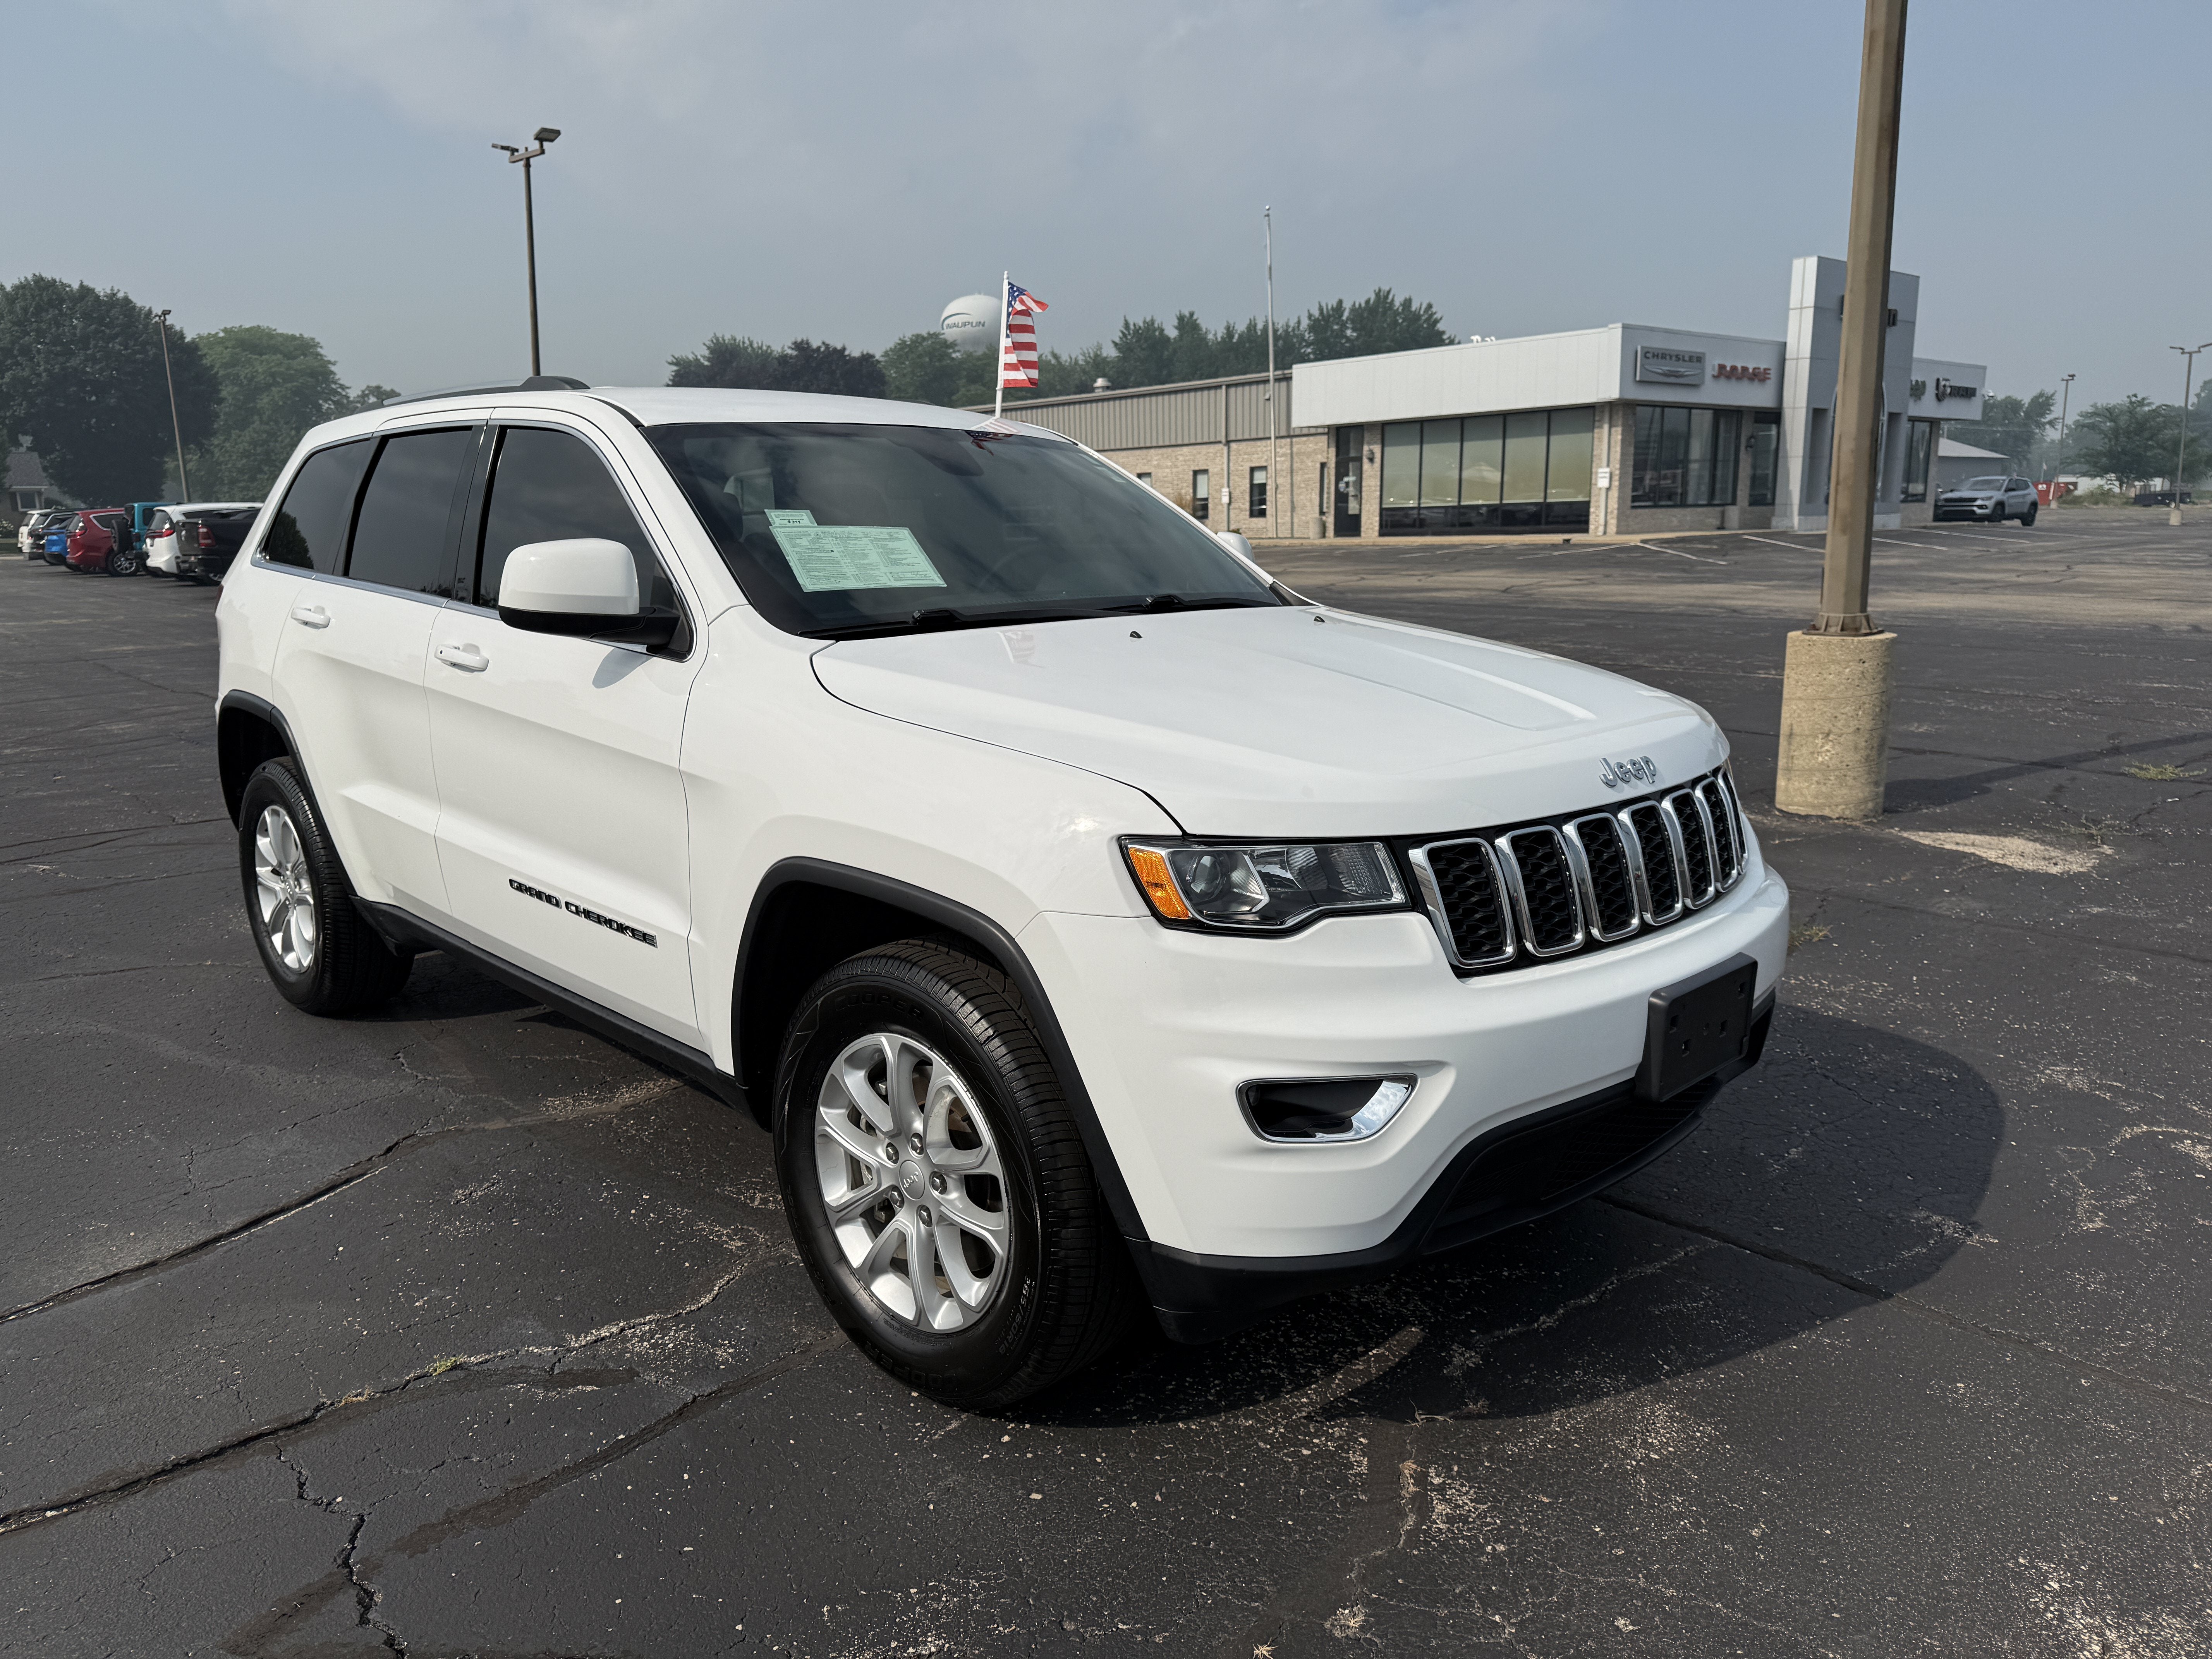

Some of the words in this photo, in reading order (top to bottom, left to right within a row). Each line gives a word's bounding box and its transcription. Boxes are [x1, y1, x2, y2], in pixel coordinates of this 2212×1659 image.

[945, 321, 986, 329] WAUPUN
[1644, 351, 1702, 364] CHRYSLER
[1599, 756, 1656, 788] Jeep
[509, 878, 562, 909] GRAND
[565, 900, 658, 949] CHEROKEE
[835, 993, 924, 1024] COOPER
[863, 1340, 957, 1388] COOPER
